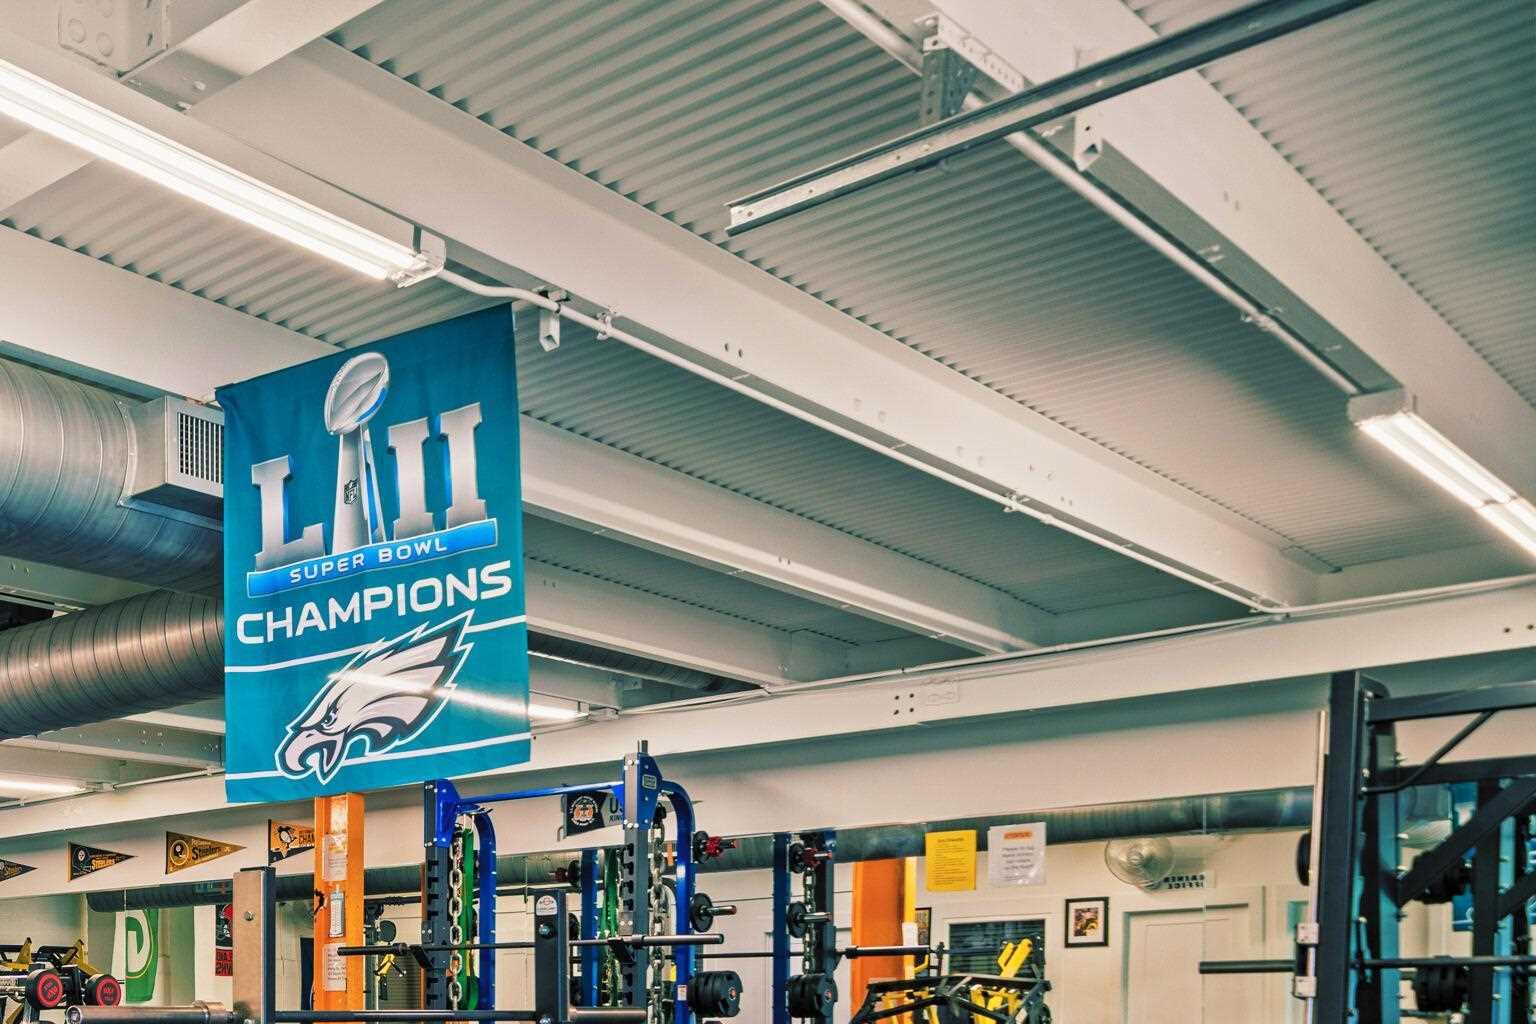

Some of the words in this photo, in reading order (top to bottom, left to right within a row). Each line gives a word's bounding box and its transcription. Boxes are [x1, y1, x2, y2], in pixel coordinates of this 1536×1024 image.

[290, 554, 364, 584] SUPER
[378, 538, 448, 563] BOWL
[236, 560, 512, 645] CHAMPIONS
